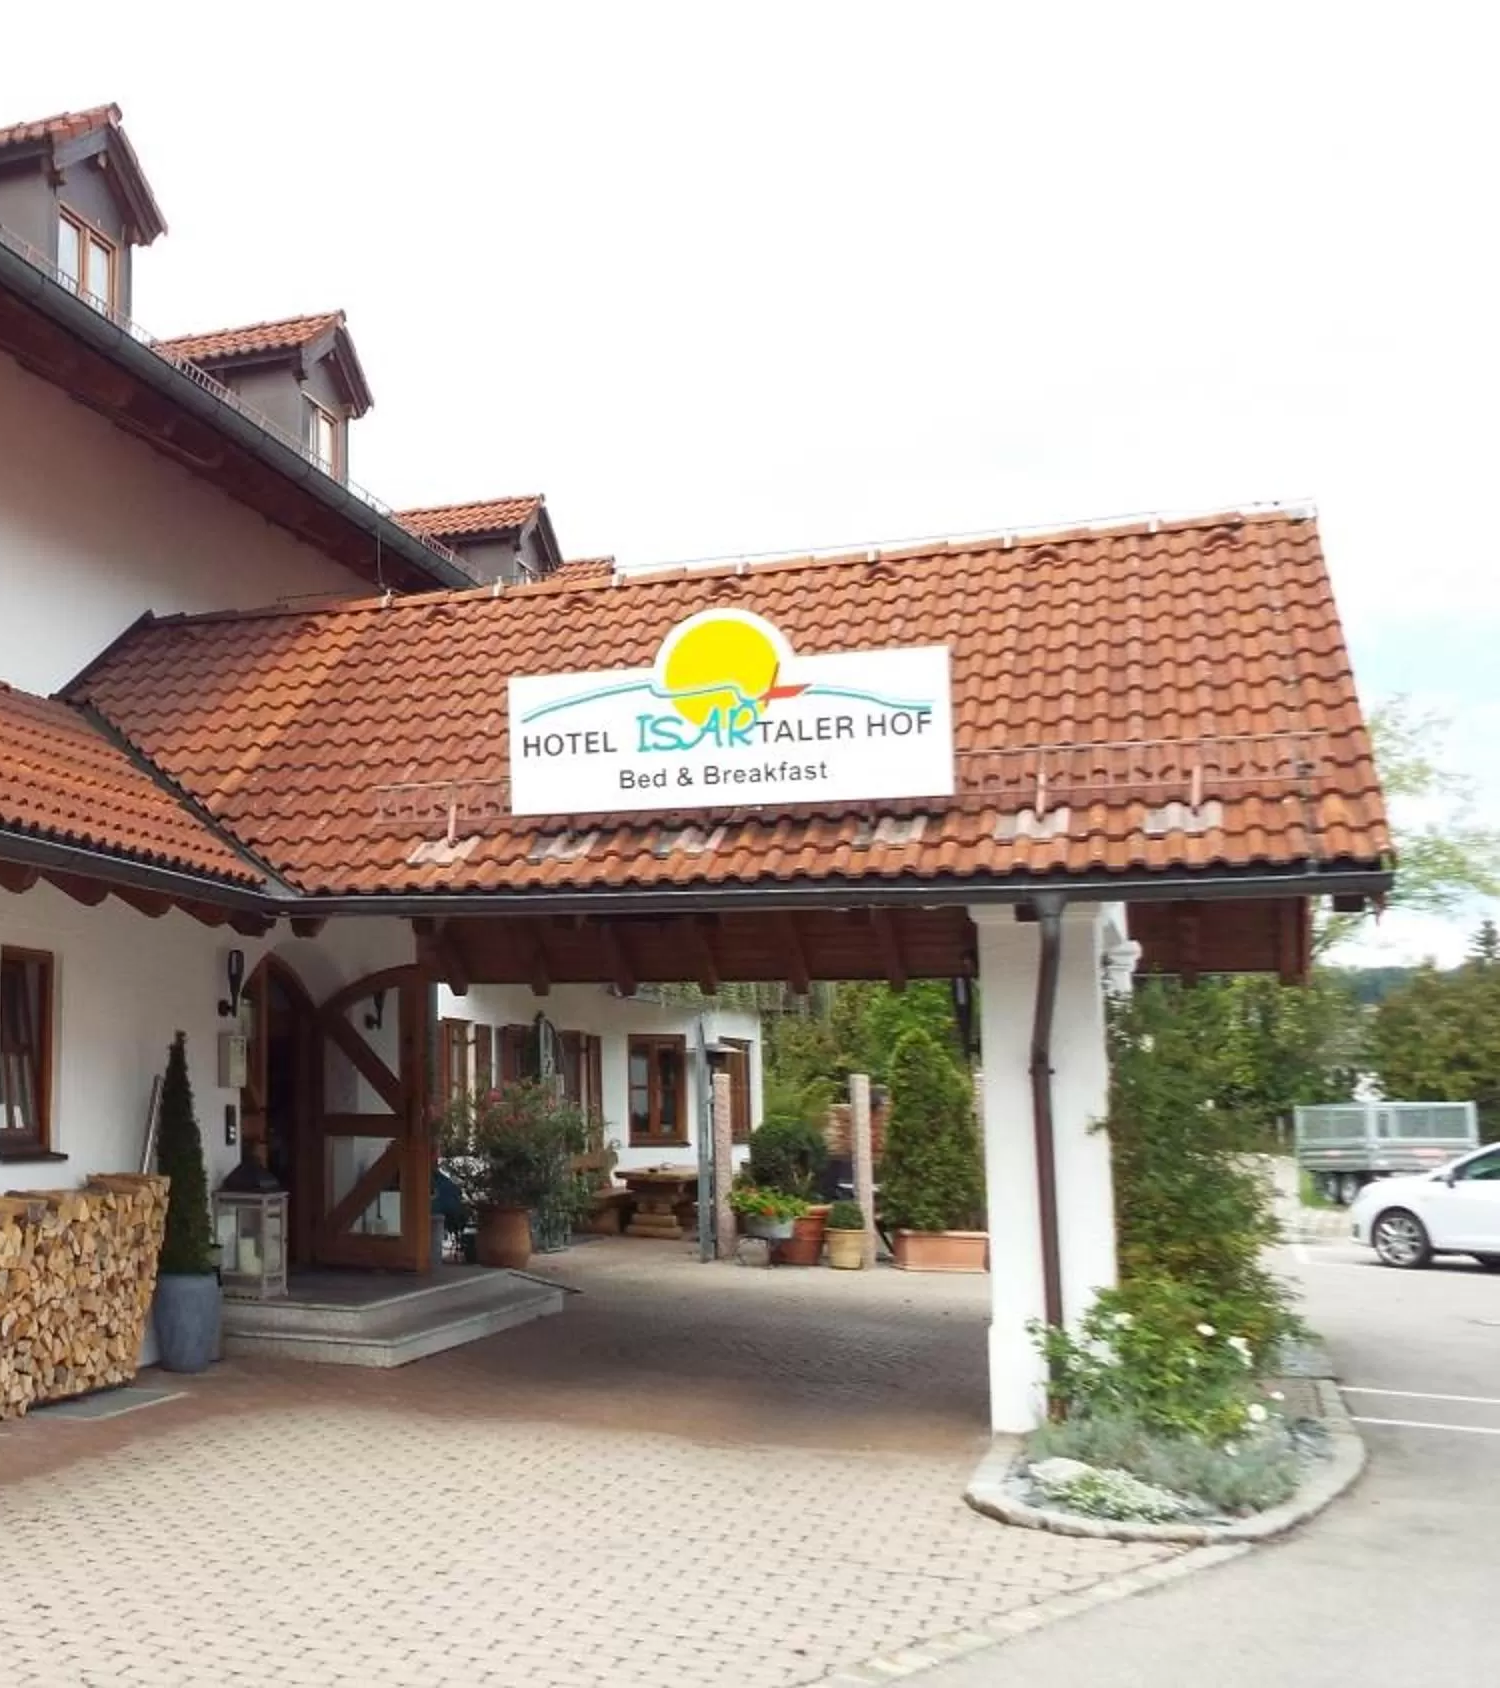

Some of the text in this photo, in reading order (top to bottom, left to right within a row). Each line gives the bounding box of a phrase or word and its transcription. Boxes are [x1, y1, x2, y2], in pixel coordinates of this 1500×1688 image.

[522, 731, 617, 758] HOTEL
[867, 710, 933, 737] HOF
[619, 760, 829, 789] Bed & Breakfast
